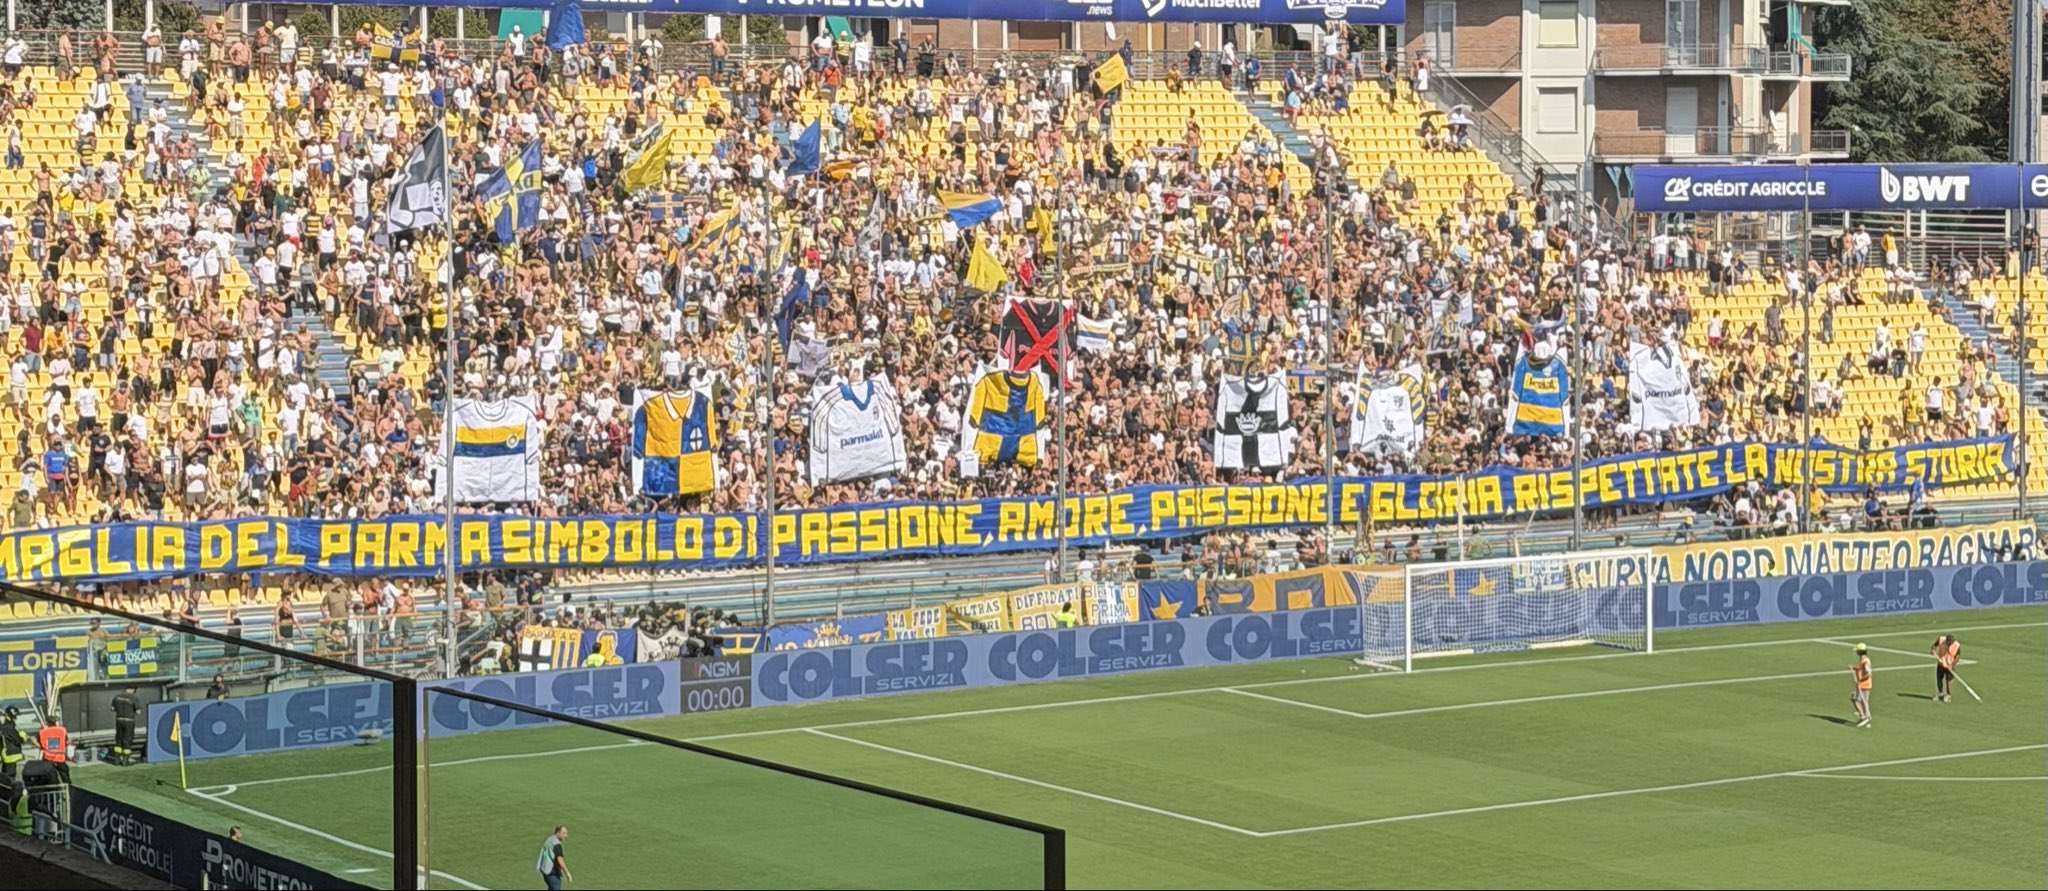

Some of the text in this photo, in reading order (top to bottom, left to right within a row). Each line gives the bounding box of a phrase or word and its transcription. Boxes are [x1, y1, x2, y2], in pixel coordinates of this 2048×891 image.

[1692, 175, 1747, 197] CRÉDIT
[1749, 181, 1826, 197] AGRICOLE
[1902, 176, 1970, 201] BWT
[840, 428, 883, 449] parmalat
[200, 520, 305, 569] DEL
[318, 520, 491, 567] PARMA
[502, 518, 704, 565] SIMBOLO
[714, 515, 757, 558] DI
[772, 504, 994, 556] PASSIONE,
[1150, 483, 1328, 532] PASSIONE
[1339, 484, 1365, 522] E
[1512, 450, 1720, 512] RISPETTATE
[1724, 443, 1768, 484] LA
[1773, 446, 1898, 486] NOSTRA
[1904, 442, 2010, 486] STORIA
[1684, 548, 1777, 584] NORD
[1784, 540, 1911, 577] MATTEO
[1015, 586, 1079, 611] DIFFIDATI
[1778, 567, 1936, 618] COLSER
[955, 600, 1000, 618] ULTRAS
[1091, 603, 1131, 618] PRIMA
[1687, 608, 1751, 625] SERVIZI
[1865, 598, 1925, 613] SERVIZI
[892, 607, 940, 629] LA FEDE
[125, 648, 156, 665] TOSCANA
[988, 621, 1187, 682] COLSER
[1308, 639, 1362, 653] SERVI
[8, 650, 81, 673] LORIS
[758, 638, 969, 703] COLSER
[1098, 654, 1172, 671] SERVIZI
[876, 672, 954, 692] SERVIZI
[432, 665, 666, 731] COLSER
[688, 685, 745, 713] 00:00
[297, 718, 394, 744] SERVIZ
[110, 812, 153, 846] CRÉDIT
[109, 838, 171, 875] AGRICOLE
